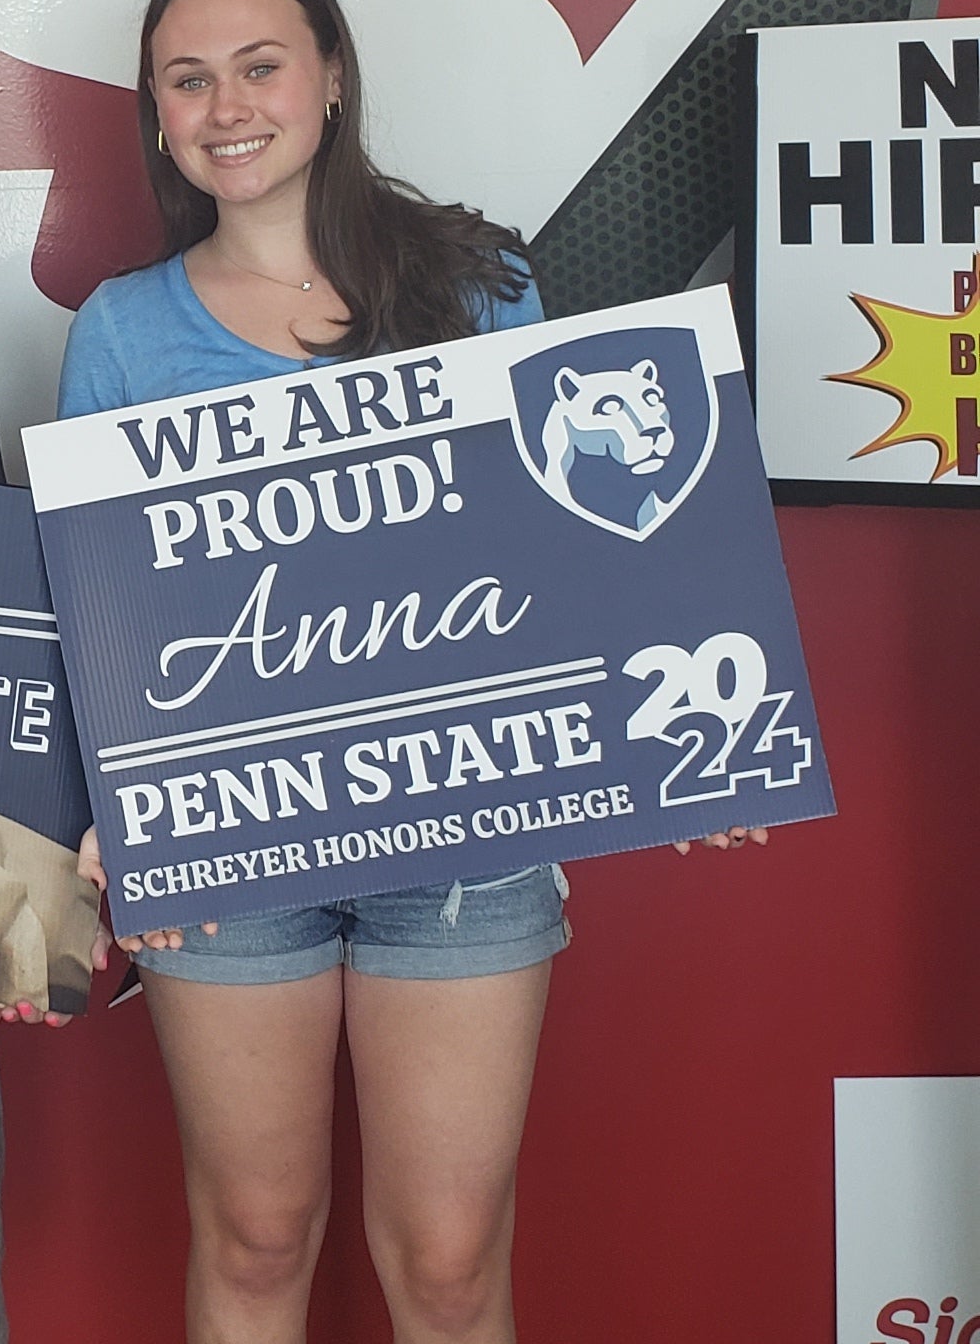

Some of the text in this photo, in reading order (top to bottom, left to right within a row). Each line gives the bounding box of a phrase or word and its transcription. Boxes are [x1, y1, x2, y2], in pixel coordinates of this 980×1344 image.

[117, 356, 453, 480] WE ARE
[143, 439, 463, 570] PROUD!
[145, 563, 532, 711] Anna
[115, 702, 602, 846] PENN STATE
[122, 784, 634, 903] SCHREYER HONORS COLLEGE
